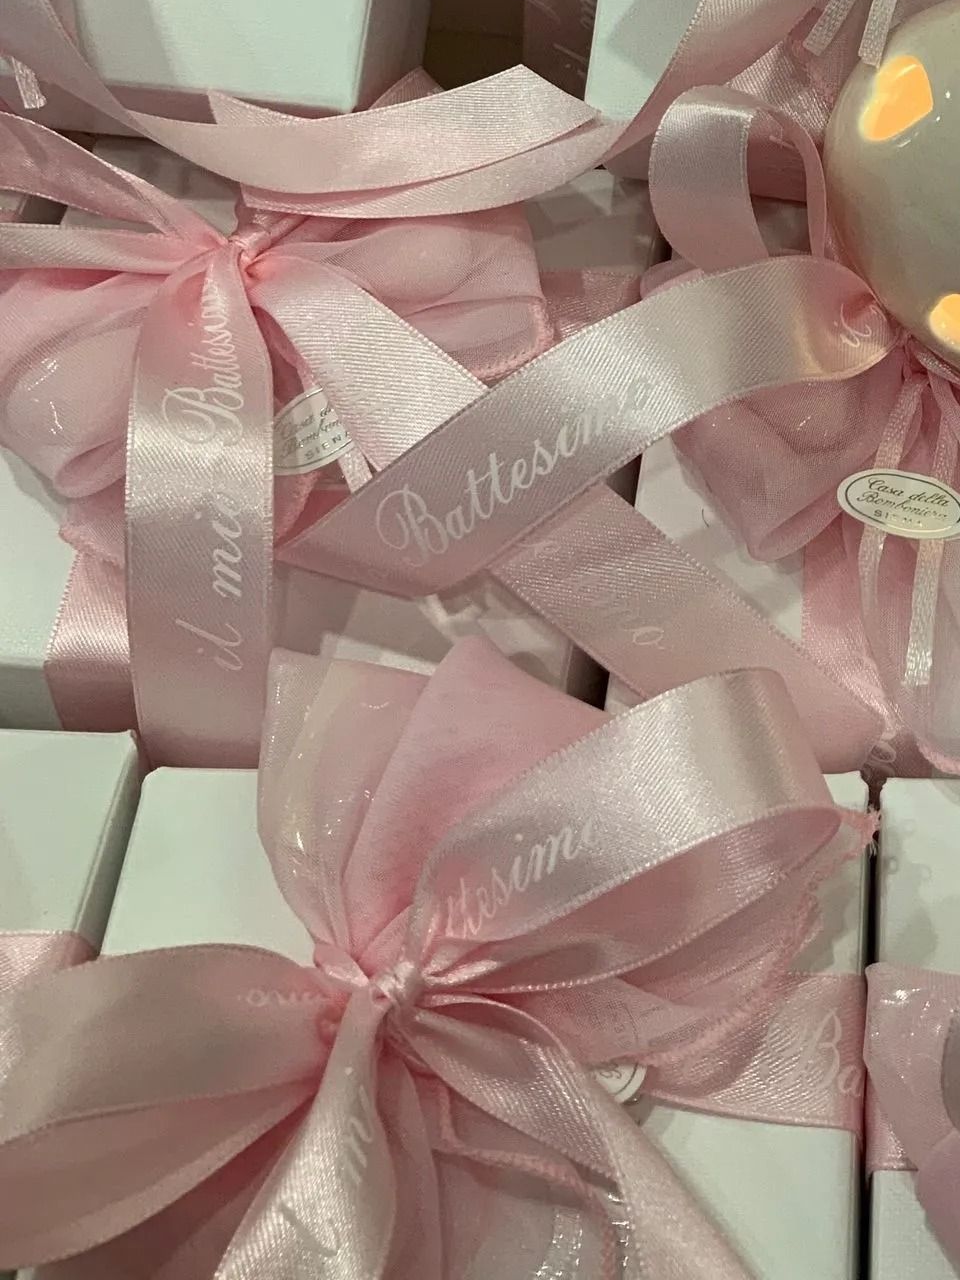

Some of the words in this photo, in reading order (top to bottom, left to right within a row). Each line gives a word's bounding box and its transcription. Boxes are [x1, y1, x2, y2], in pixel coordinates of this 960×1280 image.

[856, 489, 949, 520] Bomboniera
[867, 477, 905, 497] Casa
[908, 491, 950, 507] della
